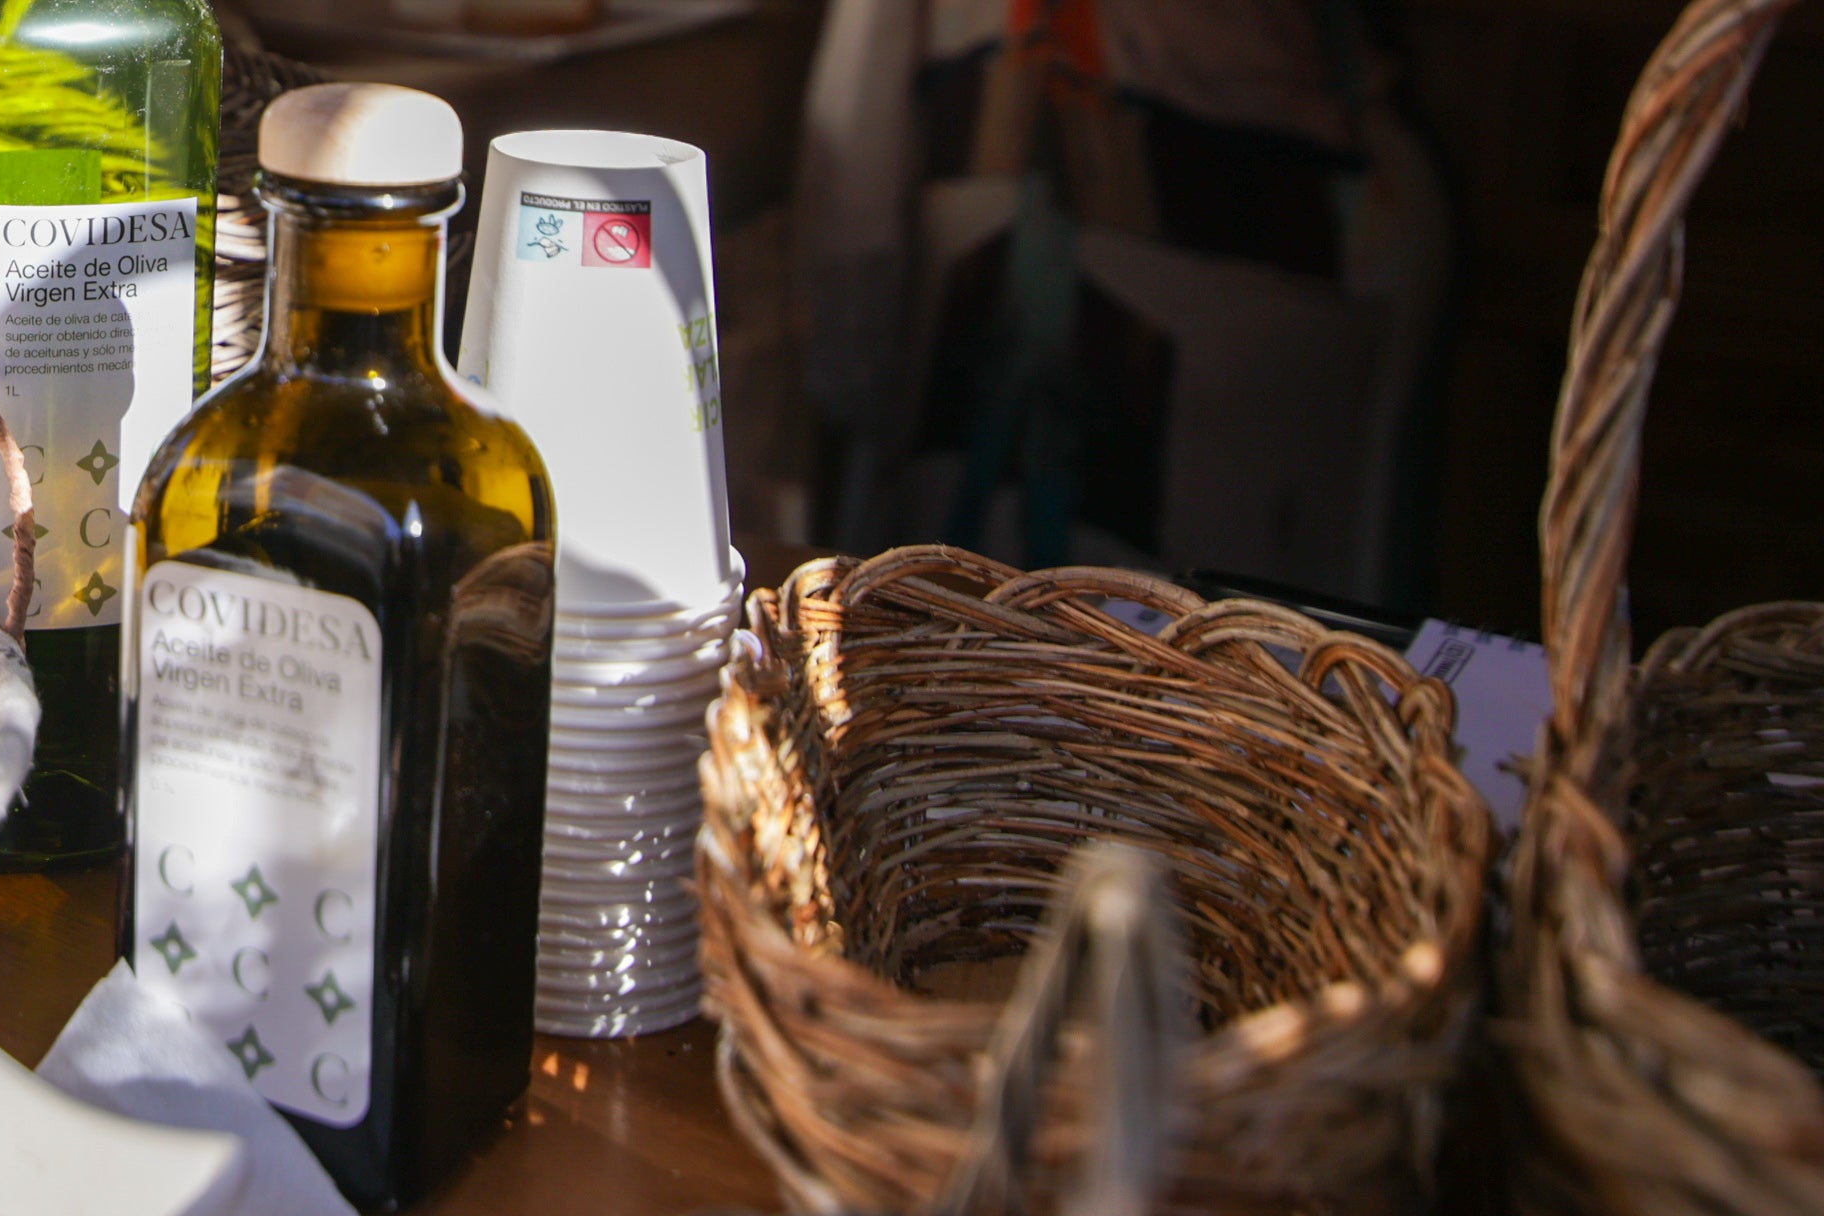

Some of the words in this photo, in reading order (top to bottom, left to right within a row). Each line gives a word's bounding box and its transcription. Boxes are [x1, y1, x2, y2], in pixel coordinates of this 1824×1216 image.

[523, 194, 572, 210] PRODUCTO
[3, 211, 191, 247] COVIDESA
[5, 259, 77, 279] Aceite
[84, 257, 111, 277] de
[118, 255, 168, 275] Oliva
[5, 282, 76, 308] Virgen
[84, 280, 138, 301] Extra
[5, 314, 43, 326] Aceite
[46, 313, 61, 325] de
[64, 312, 90, 325] oliva
[93, 311, 108, 324] de
[5, 330, 53, 344] superior
[56, 328, 107, 342] obtenido
[4, 360, 94, 376] procedimientos
[5, 346, 20, 358] de
[23, 345, 80, 358] aceitunas
[82, 348, 90, 359] y
[92, 344, 116, 356] sólo
[5, 386, 20, 397] 1L
[79, 507, 112, 549] C
[148, 579, 372, 662] COVIDESA
[152, 628, 231, 665] Aceite
[238, 647, 272, 674] de
[278, 653, 342, 694] Oliva
[152, 655, 231, 693] Virgen
[238, 673, 304, 712] Extra
[159, 843, 195, 897] C
[315, 888, 354, 944] C
[232, 945, 270, 1002] C
[311, 1051, 350, 1108] C
